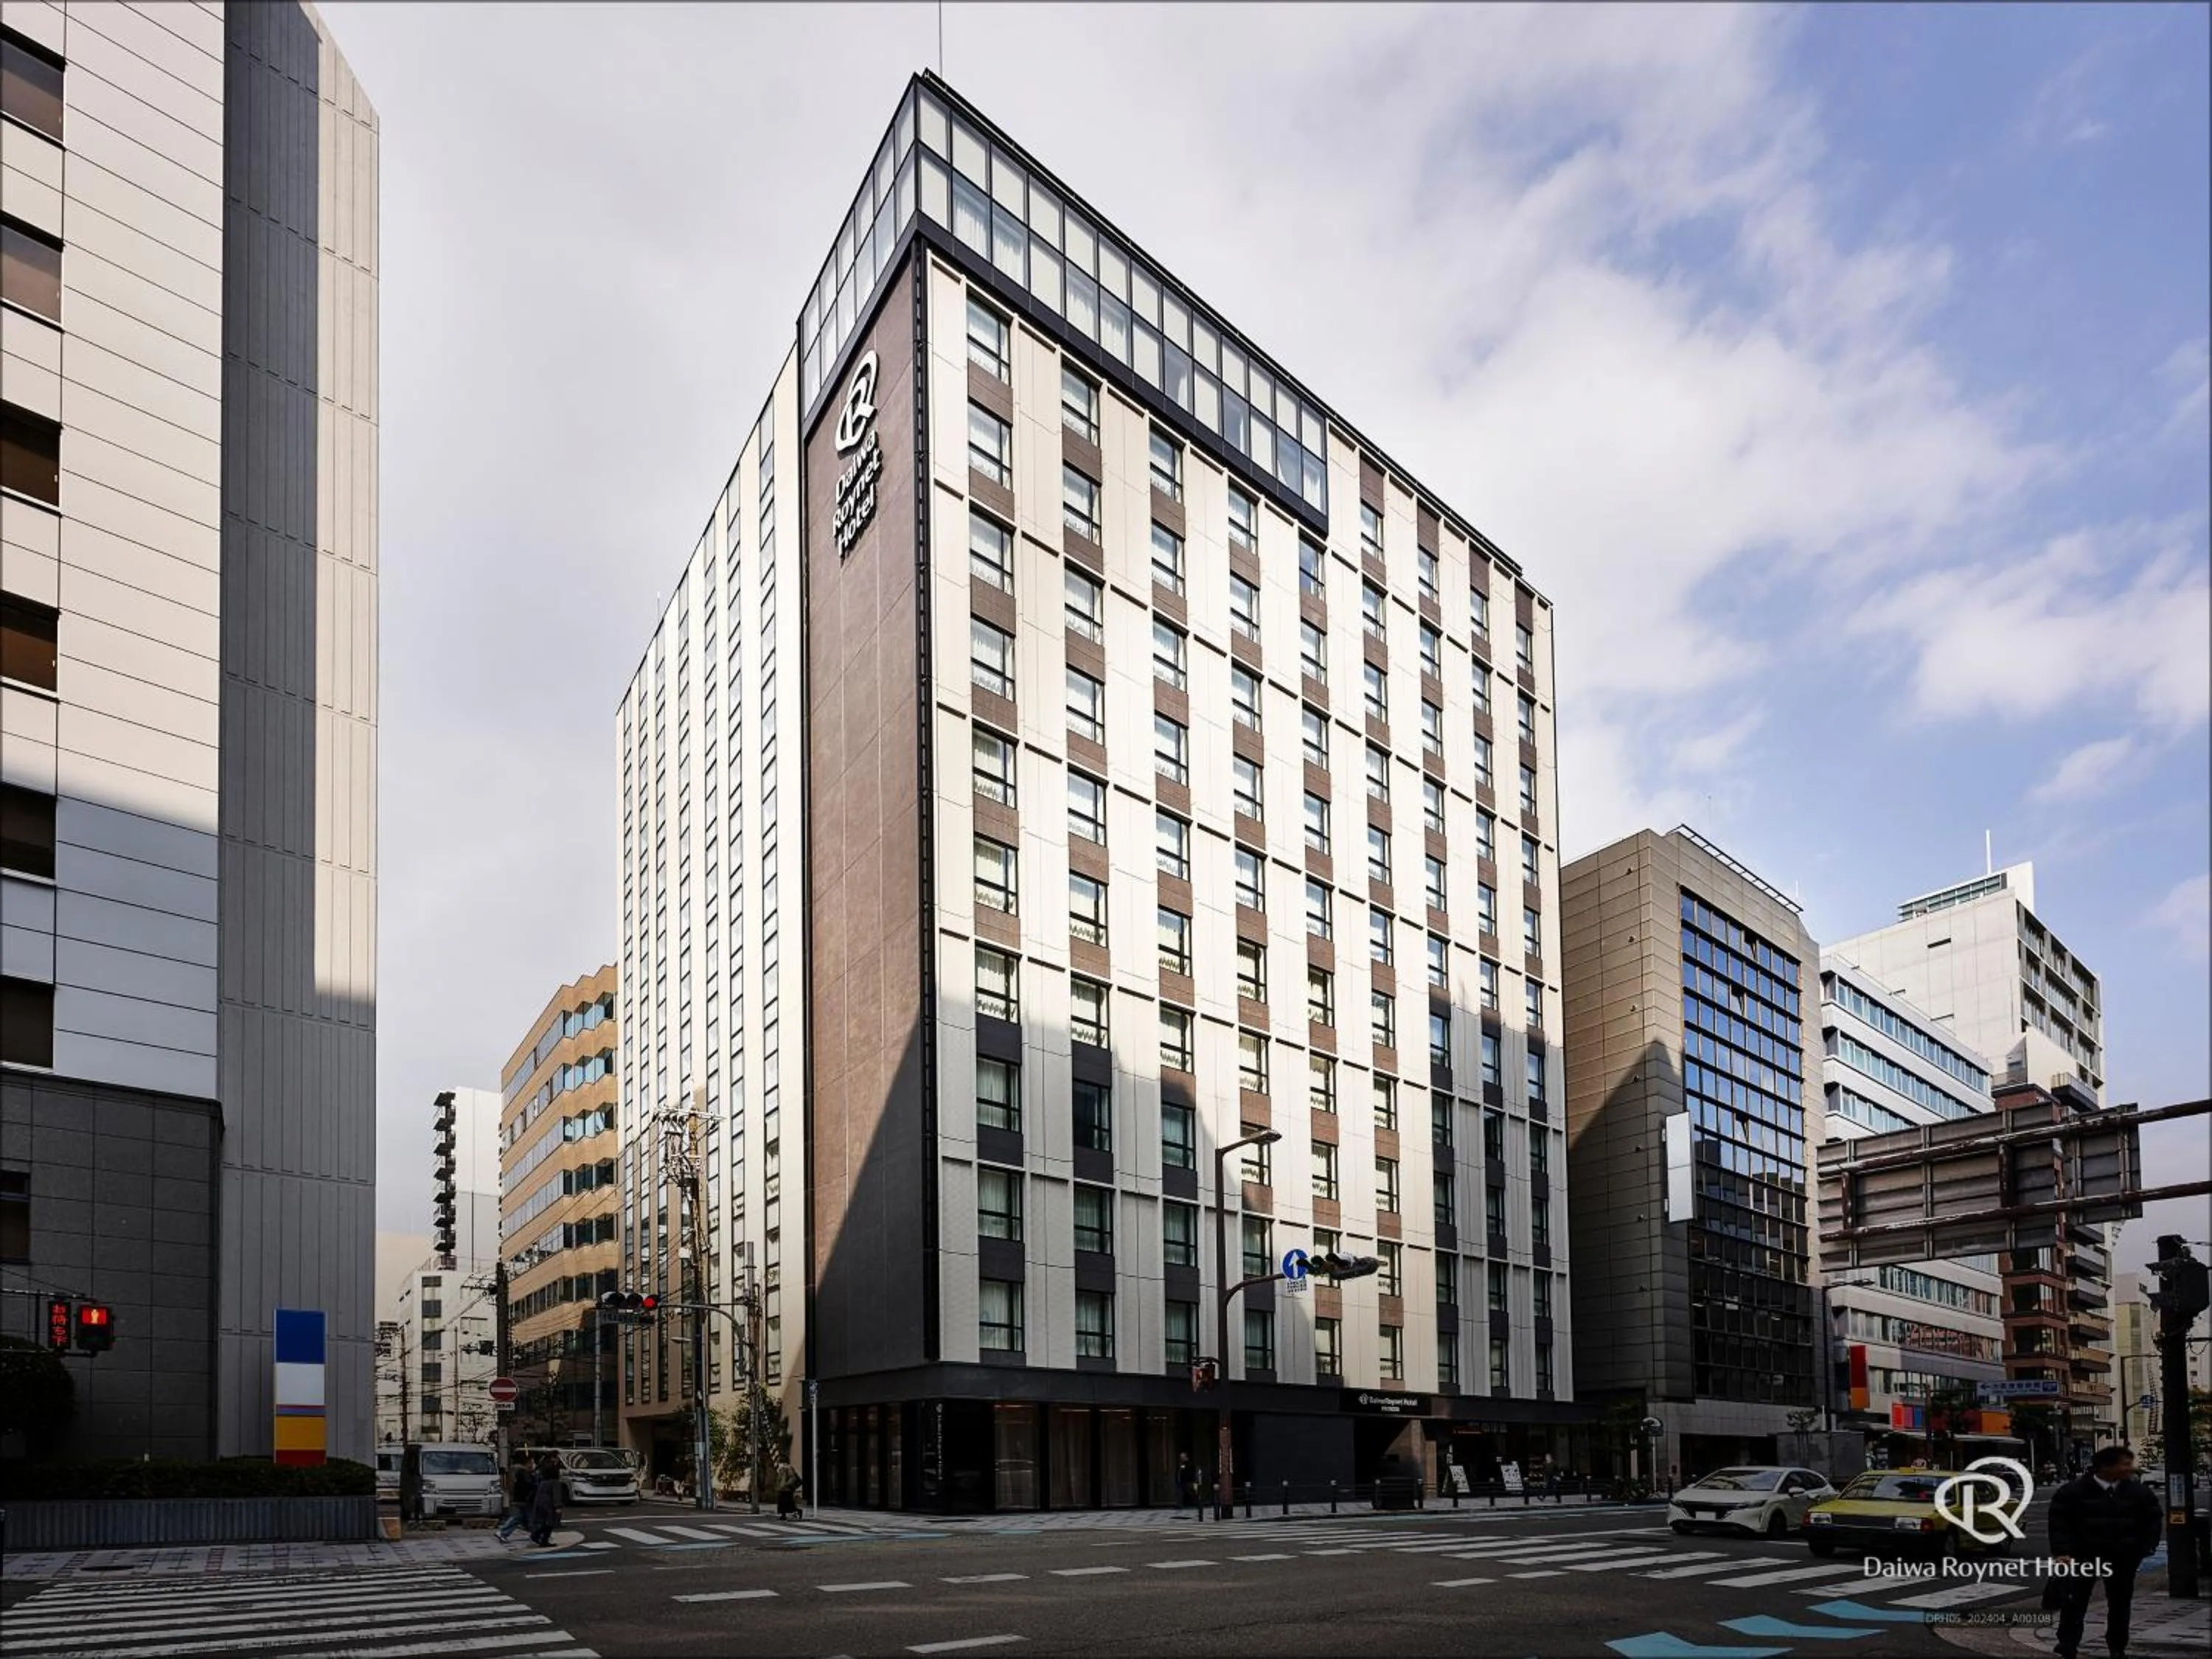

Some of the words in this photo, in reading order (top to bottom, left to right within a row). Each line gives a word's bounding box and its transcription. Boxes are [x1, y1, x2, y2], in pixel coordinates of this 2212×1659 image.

[832, 448, 880, 537] Roynet
[836, 430, 876, 504] Daiwa
[838, 484, 875, 557] Hotel
